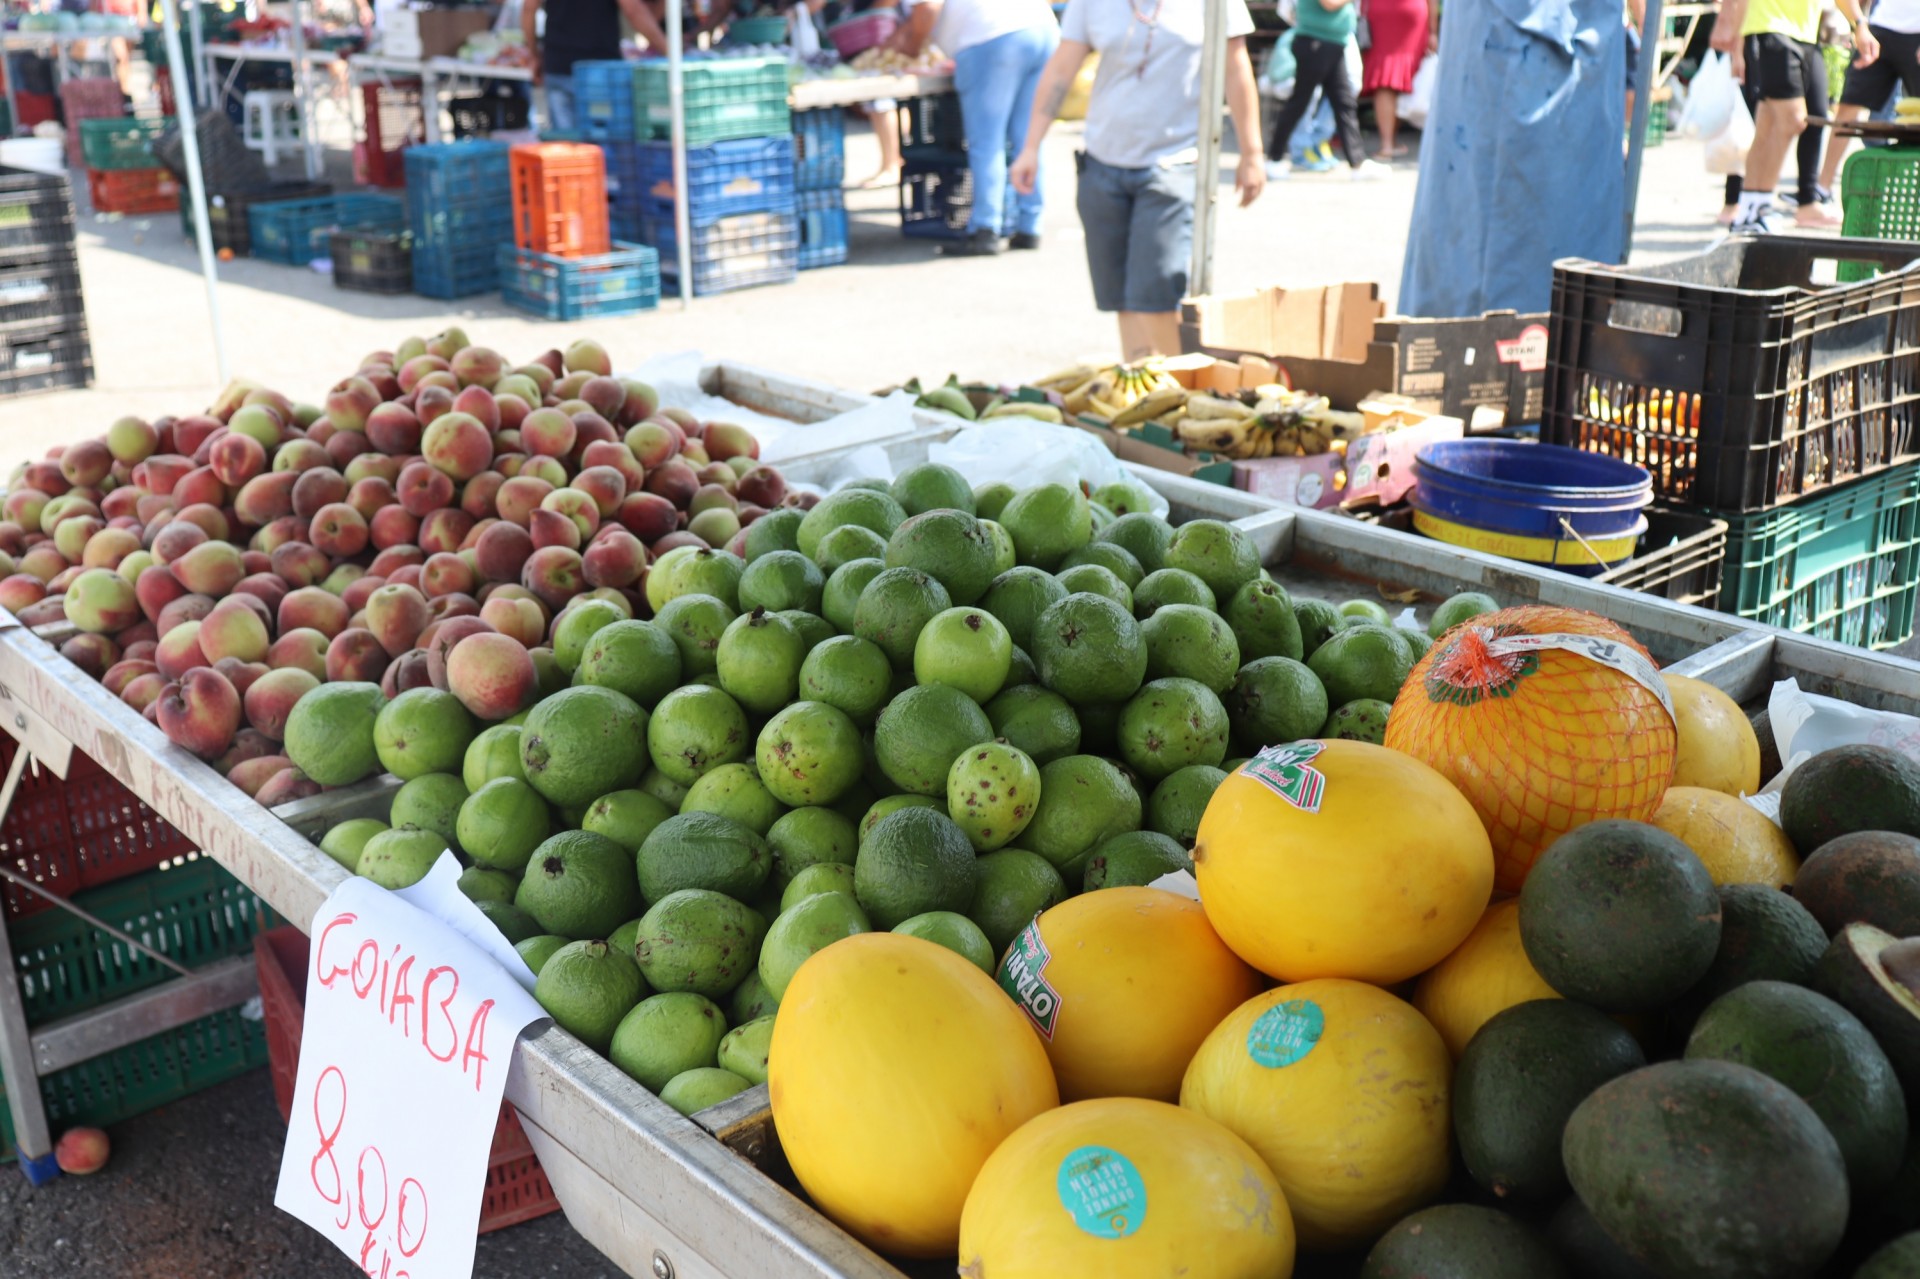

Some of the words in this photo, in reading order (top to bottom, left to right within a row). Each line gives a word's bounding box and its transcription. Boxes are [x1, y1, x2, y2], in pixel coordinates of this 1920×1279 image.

[1006, 948, 1053, 1018] OTANI
[1253, 1030, 1303, 1048] MELON
[310, 1065, 428, 1258] 8,00
[1069, 1160, 1124, 1193] MELON
[1081, 1174, 1128, 1204] CANDY
[1086, 1186, 1135, 1217] ORANGE
